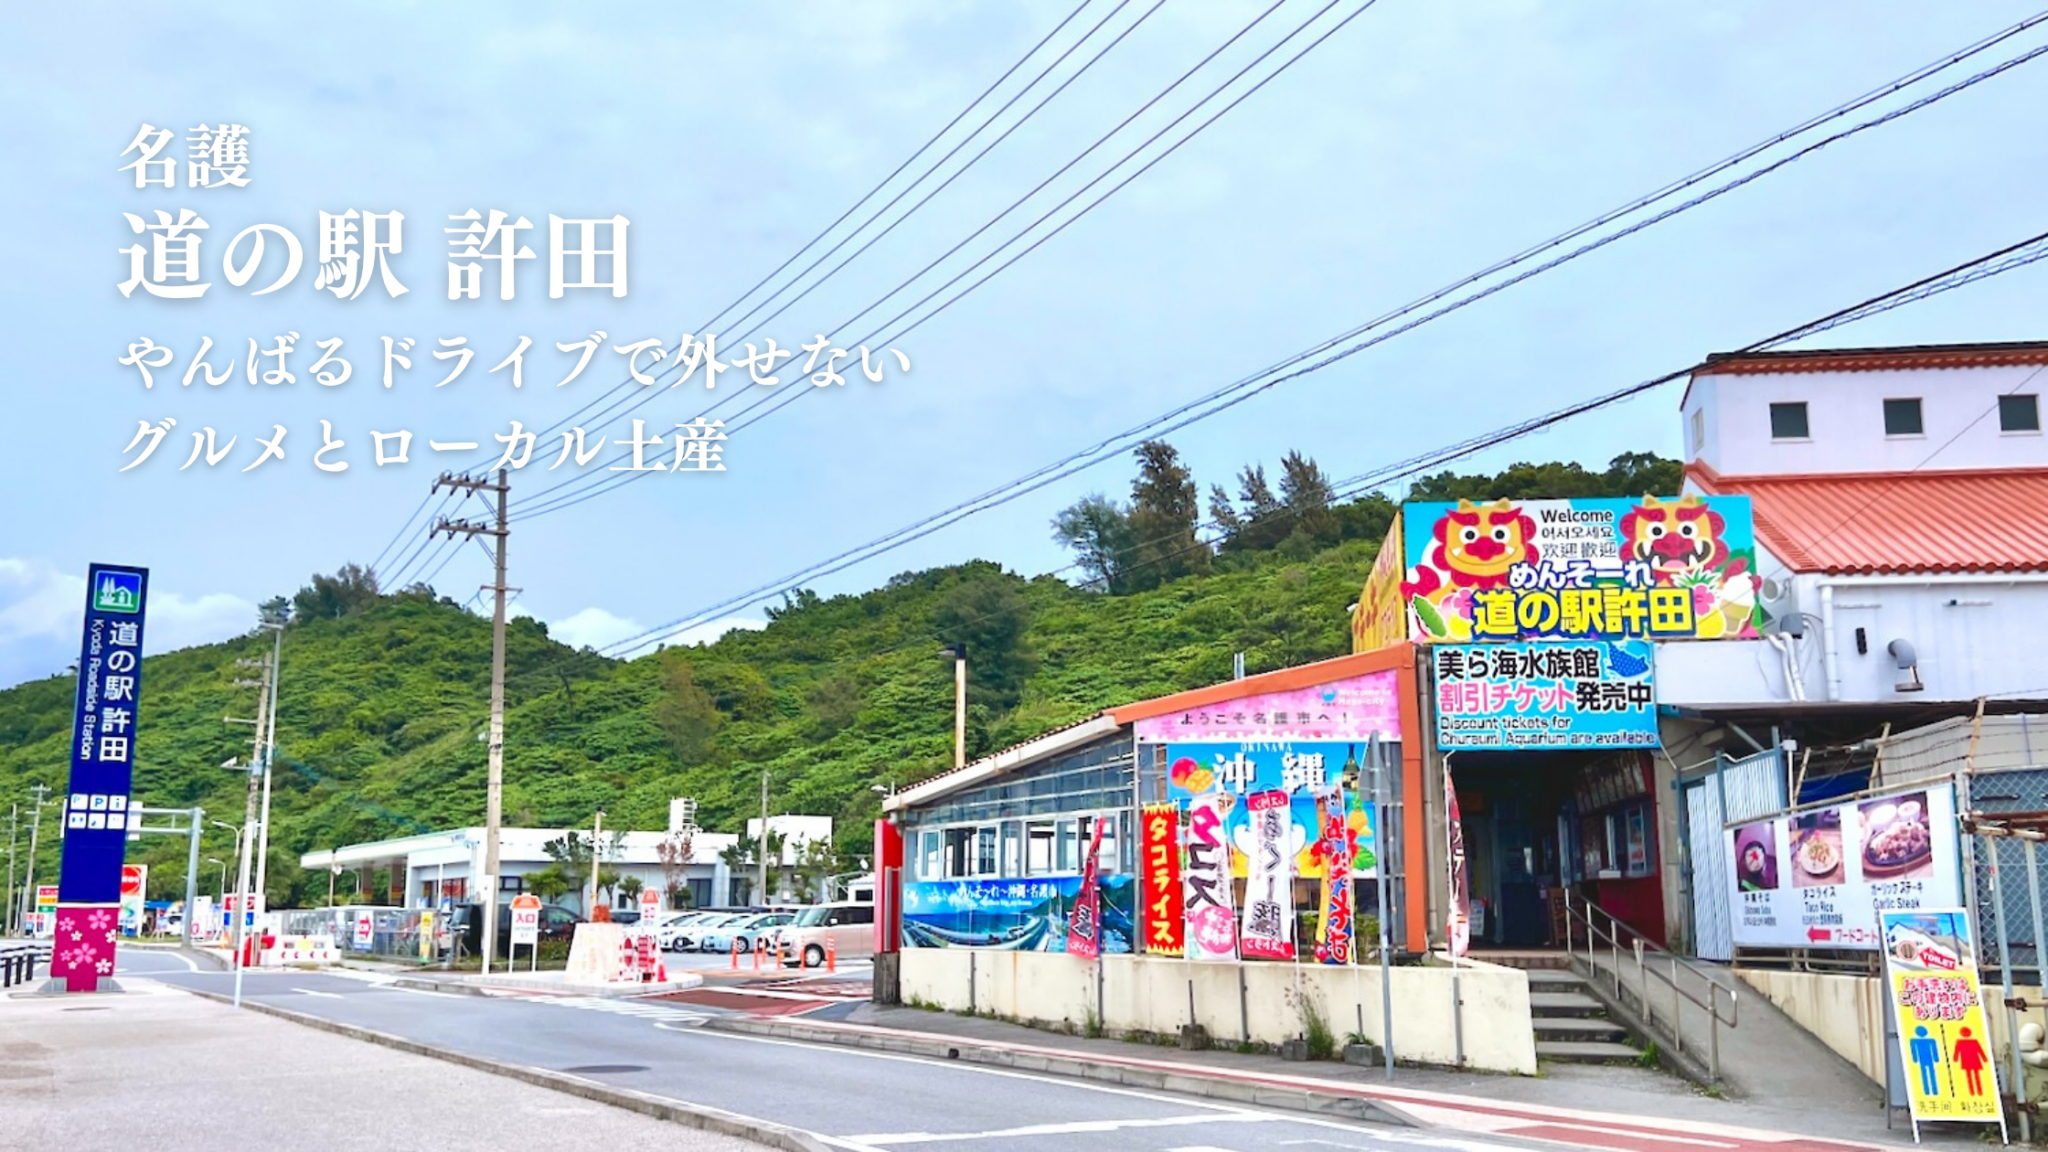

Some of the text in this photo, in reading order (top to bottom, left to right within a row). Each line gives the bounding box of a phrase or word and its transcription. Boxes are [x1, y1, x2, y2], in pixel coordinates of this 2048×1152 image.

[1541, 509, 1613, 523] Welcome
[1541, 527, 1614, 539] 어서오세요
[1509, 561, 1656, 588] めんそーれ
[1474, 588, 1693, 636] 道の駅許田
[1438, 648, 1600, 679] 美ら海水族館
[81, 619, 104, 760] Kyoda Roadside Station
[99, 621, 139, 762] 道の駅 許田
[1339, 688, 1381, 697] Welcome
[1439, 681, 1652, 713] 割引チケット発売中
[1440, 717, 1571, 729] Discount tickets for
[1505, 733, 1567, 746] Aquarium
[1571, 735, 1593, 745] are
[1595, 732, 1655, 745] available
[1240, 742, 1293, 753] OKINAWA
[1212, 752, 1327, 796] 沖縄
[1150, 816, 1175, 944] タコライス
[1803, 886, 1836, 899] タコライス
[515, 913, 536, 923] 入口
[1835, 928, 1879, 943] フードコート
[1923, 952, 1955, 968] TOILET
[1899, 990, 1979, 1006] この建物内に
[1914, 1004, 1966, 1020] あります
